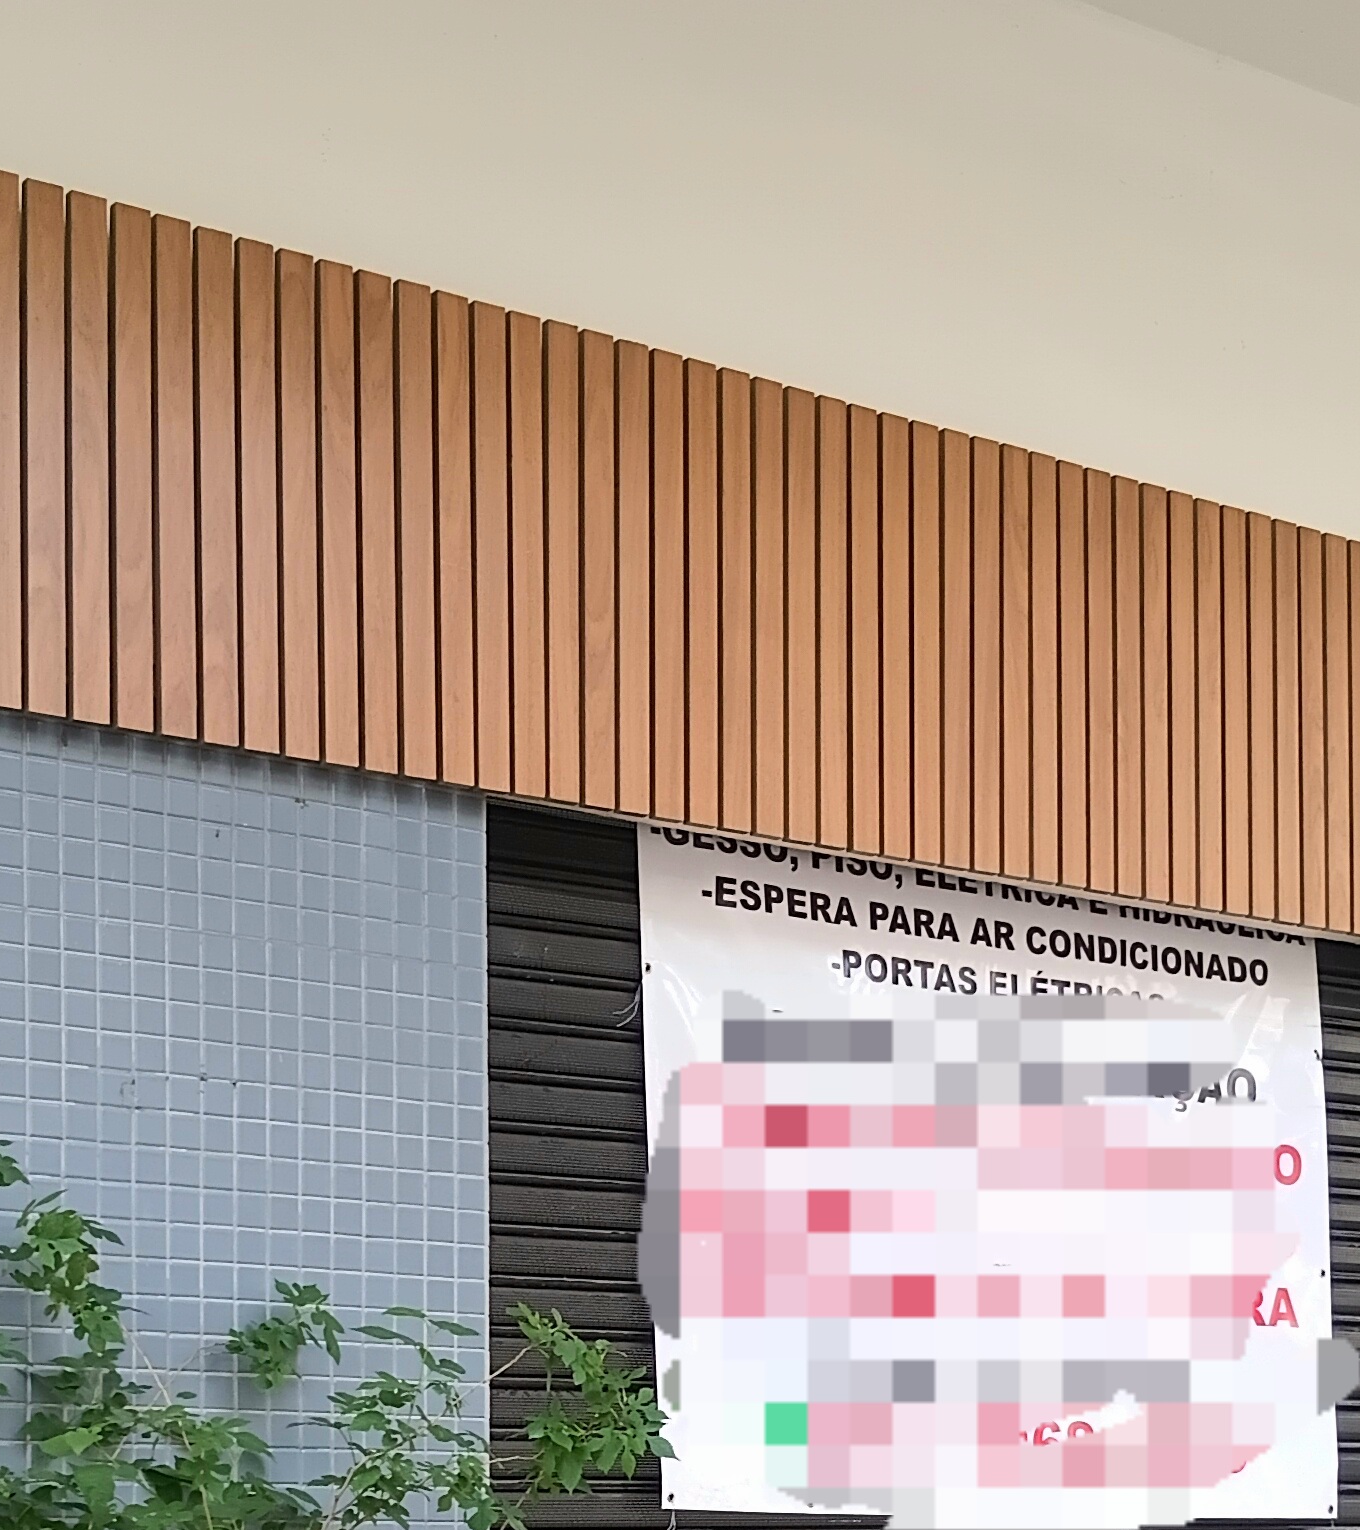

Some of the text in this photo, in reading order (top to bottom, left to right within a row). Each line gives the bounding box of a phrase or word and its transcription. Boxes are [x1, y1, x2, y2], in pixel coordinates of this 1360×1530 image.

[702, 875, 858, 928] -ESPERA
[869, 901, 960, 943] PARA
[969, 917, 1016, 951] AR
[1026, 925, 1269, 987] CONDICIONADO
[831, 949, 978, 995] -PORTAS
